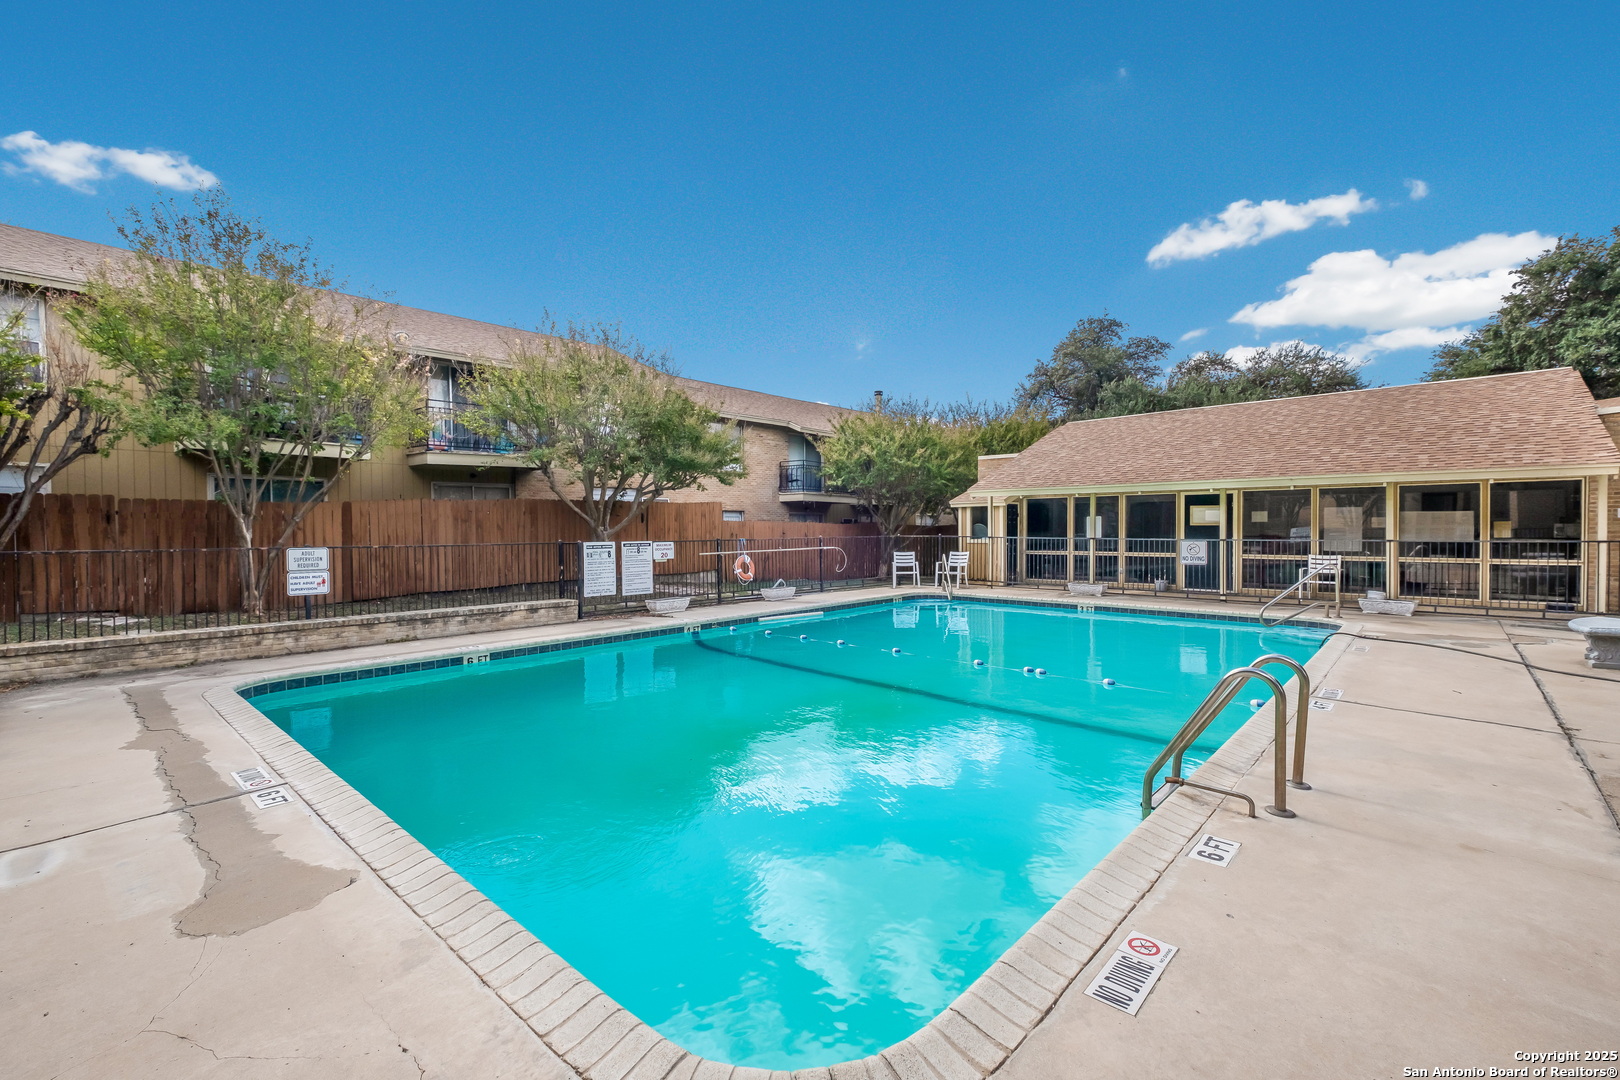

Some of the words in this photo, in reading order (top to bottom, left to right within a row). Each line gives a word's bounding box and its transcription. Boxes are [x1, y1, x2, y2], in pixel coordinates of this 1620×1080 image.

[1080, 605, 1084, 613] 3
[1086, 605, 1093, 613] FT
[467, 657, 474, 665] 6
[477, 655, 488, 663] FT
[257, 790, 280, 798] 6
[260, 795, 289, 806] FT
[1203, 836, 1234, 853] FT
[1196, 850, 1225, 861] 6
[1104, 955, 1155, 994] DIVING
[1092, 984, 1134, 1010] NO
